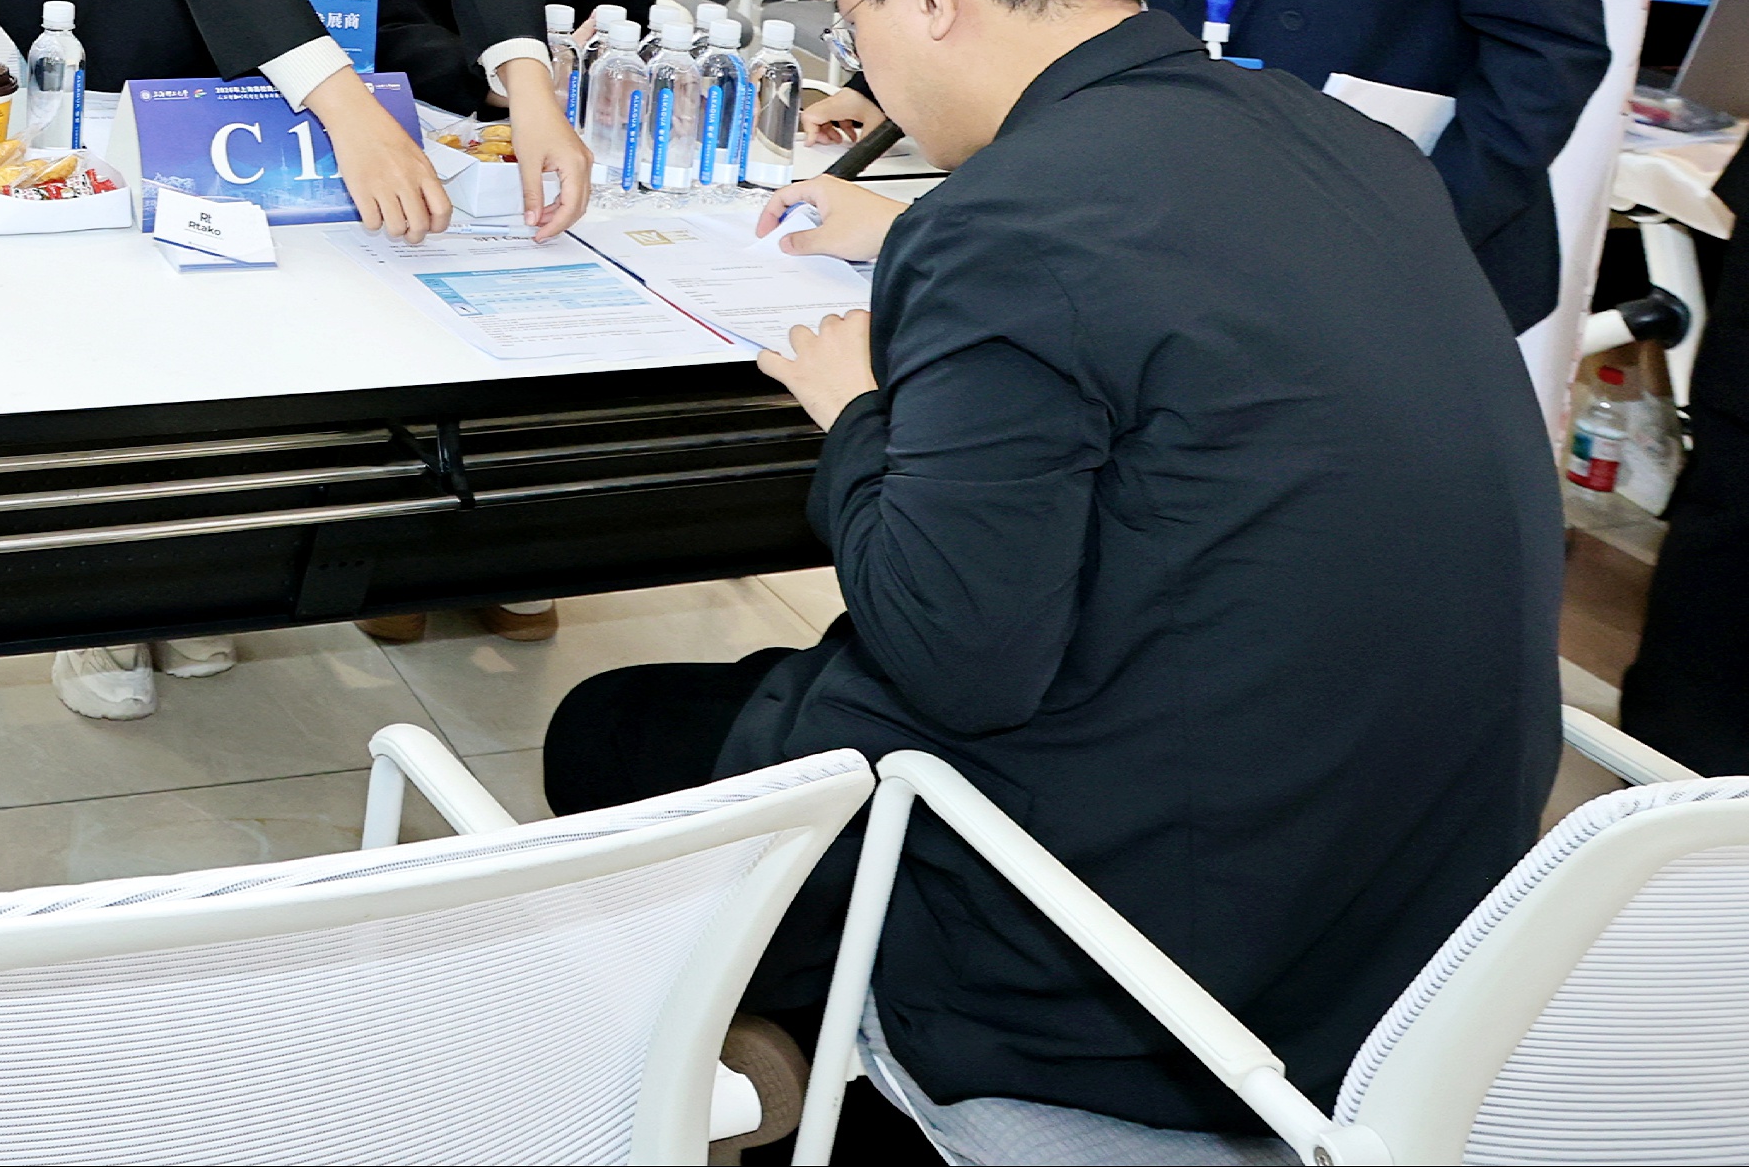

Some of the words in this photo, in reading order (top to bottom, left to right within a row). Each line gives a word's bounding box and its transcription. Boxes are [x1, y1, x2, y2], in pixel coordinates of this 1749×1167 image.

[211, 122, 264, 184] C
[287, 120, 343, 180] 1
[188, 221, 221, 236] Rtako
